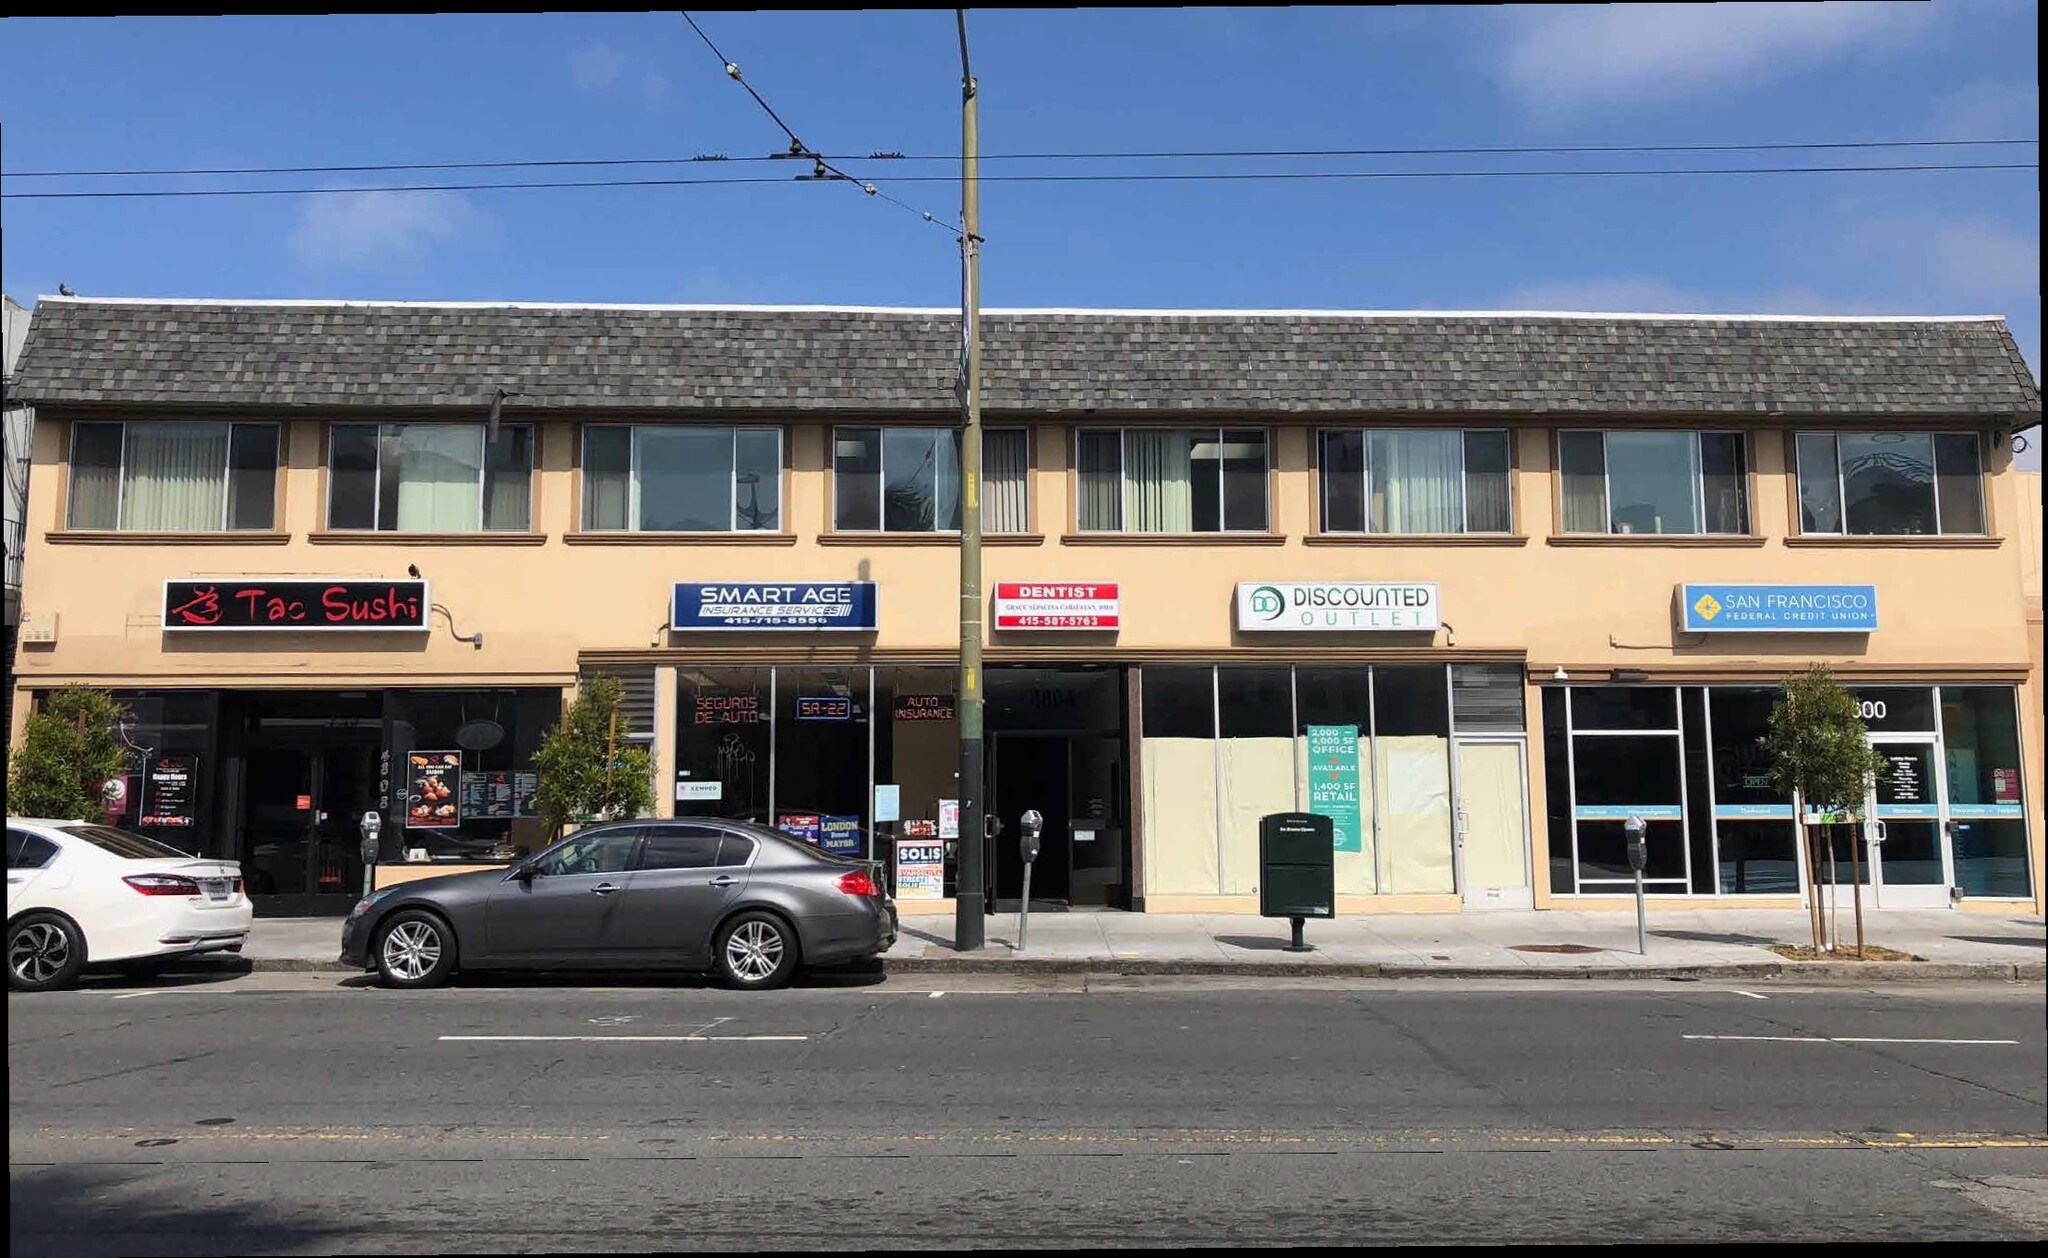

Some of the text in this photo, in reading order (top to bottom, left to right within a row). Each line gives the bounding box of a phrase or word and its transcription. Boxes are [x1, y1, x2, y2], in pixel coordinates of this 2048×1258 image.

[700, 587, 851, 603] SMART AGE
[1018, 586, 1097, 598] DENTIST
[1294, 587, 1430, 606] DISCOUNTED
[235, 585, 418, 621] Tao Sushi
[1726, 594, 1868, 610] SAN FRANCISCO
[702, 605, 840, 615] INSURANCE SERVICES
[1018, 616, 1099, 626] 415-587-5763
[1300, 611, 1421, 626] OUTLET
[1726, 612, 1868, 621] FEDERAL CREDIT UNION
[696, 697, 758, 710] SEGUROS
[906, 696, 939, 707] AUTO
[801, 702, 847, 715] SR-22
[895, 708, 954, 719] INSURANCE
[695, 711, 759, 724] DE AUTO
[1343, 737, 1356, 745] SF
[1311, 745, 1355, 754] OFFICE
[1343, 782, 1356, 791] SF
[1313, 791, 1355, 801] RETAIL
[821, 821, 858, 832] LONDON
[899, 847, 941, 861] SOLIS
